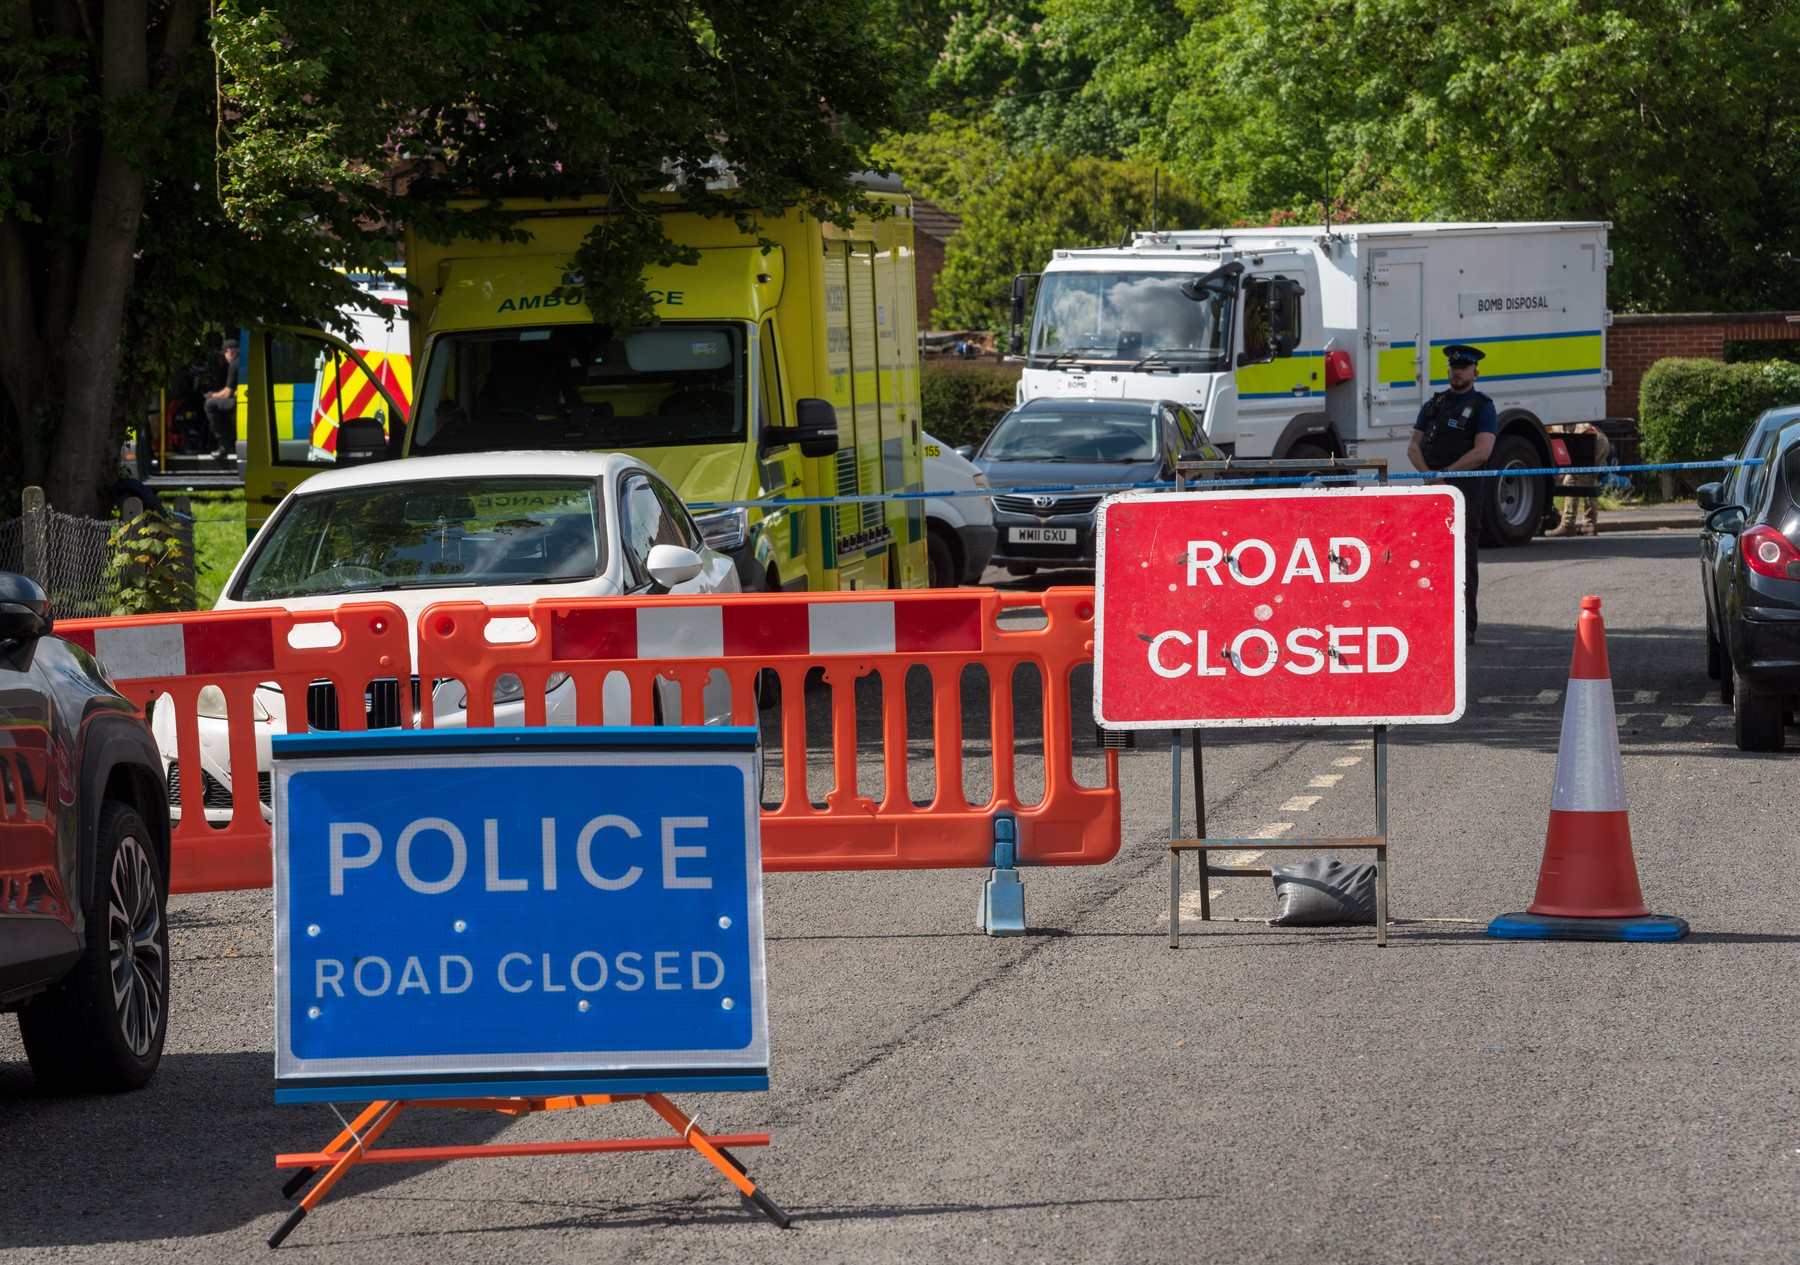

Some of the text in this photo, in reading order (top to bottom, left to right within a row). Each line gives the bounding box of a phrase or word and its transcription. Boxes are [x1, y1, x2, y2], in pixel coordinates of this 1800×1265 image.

[497, 290, 684, 313] AMBUCE
[1478, 296, 1548, 312] BOMB DISPOSAL
[1067, 381, 1087, 389] BOMB
[924, 445, 940, 457] 155
[1019, 529, 1067, 542] WM11 GXU
[1186, 537, 1371, 586] ROAD
[1147, 626, 1409, 679] CLOSED
[329, 814, 713, 896] POLICE
[315, 950, 726, 998] ROAD CLOSED
